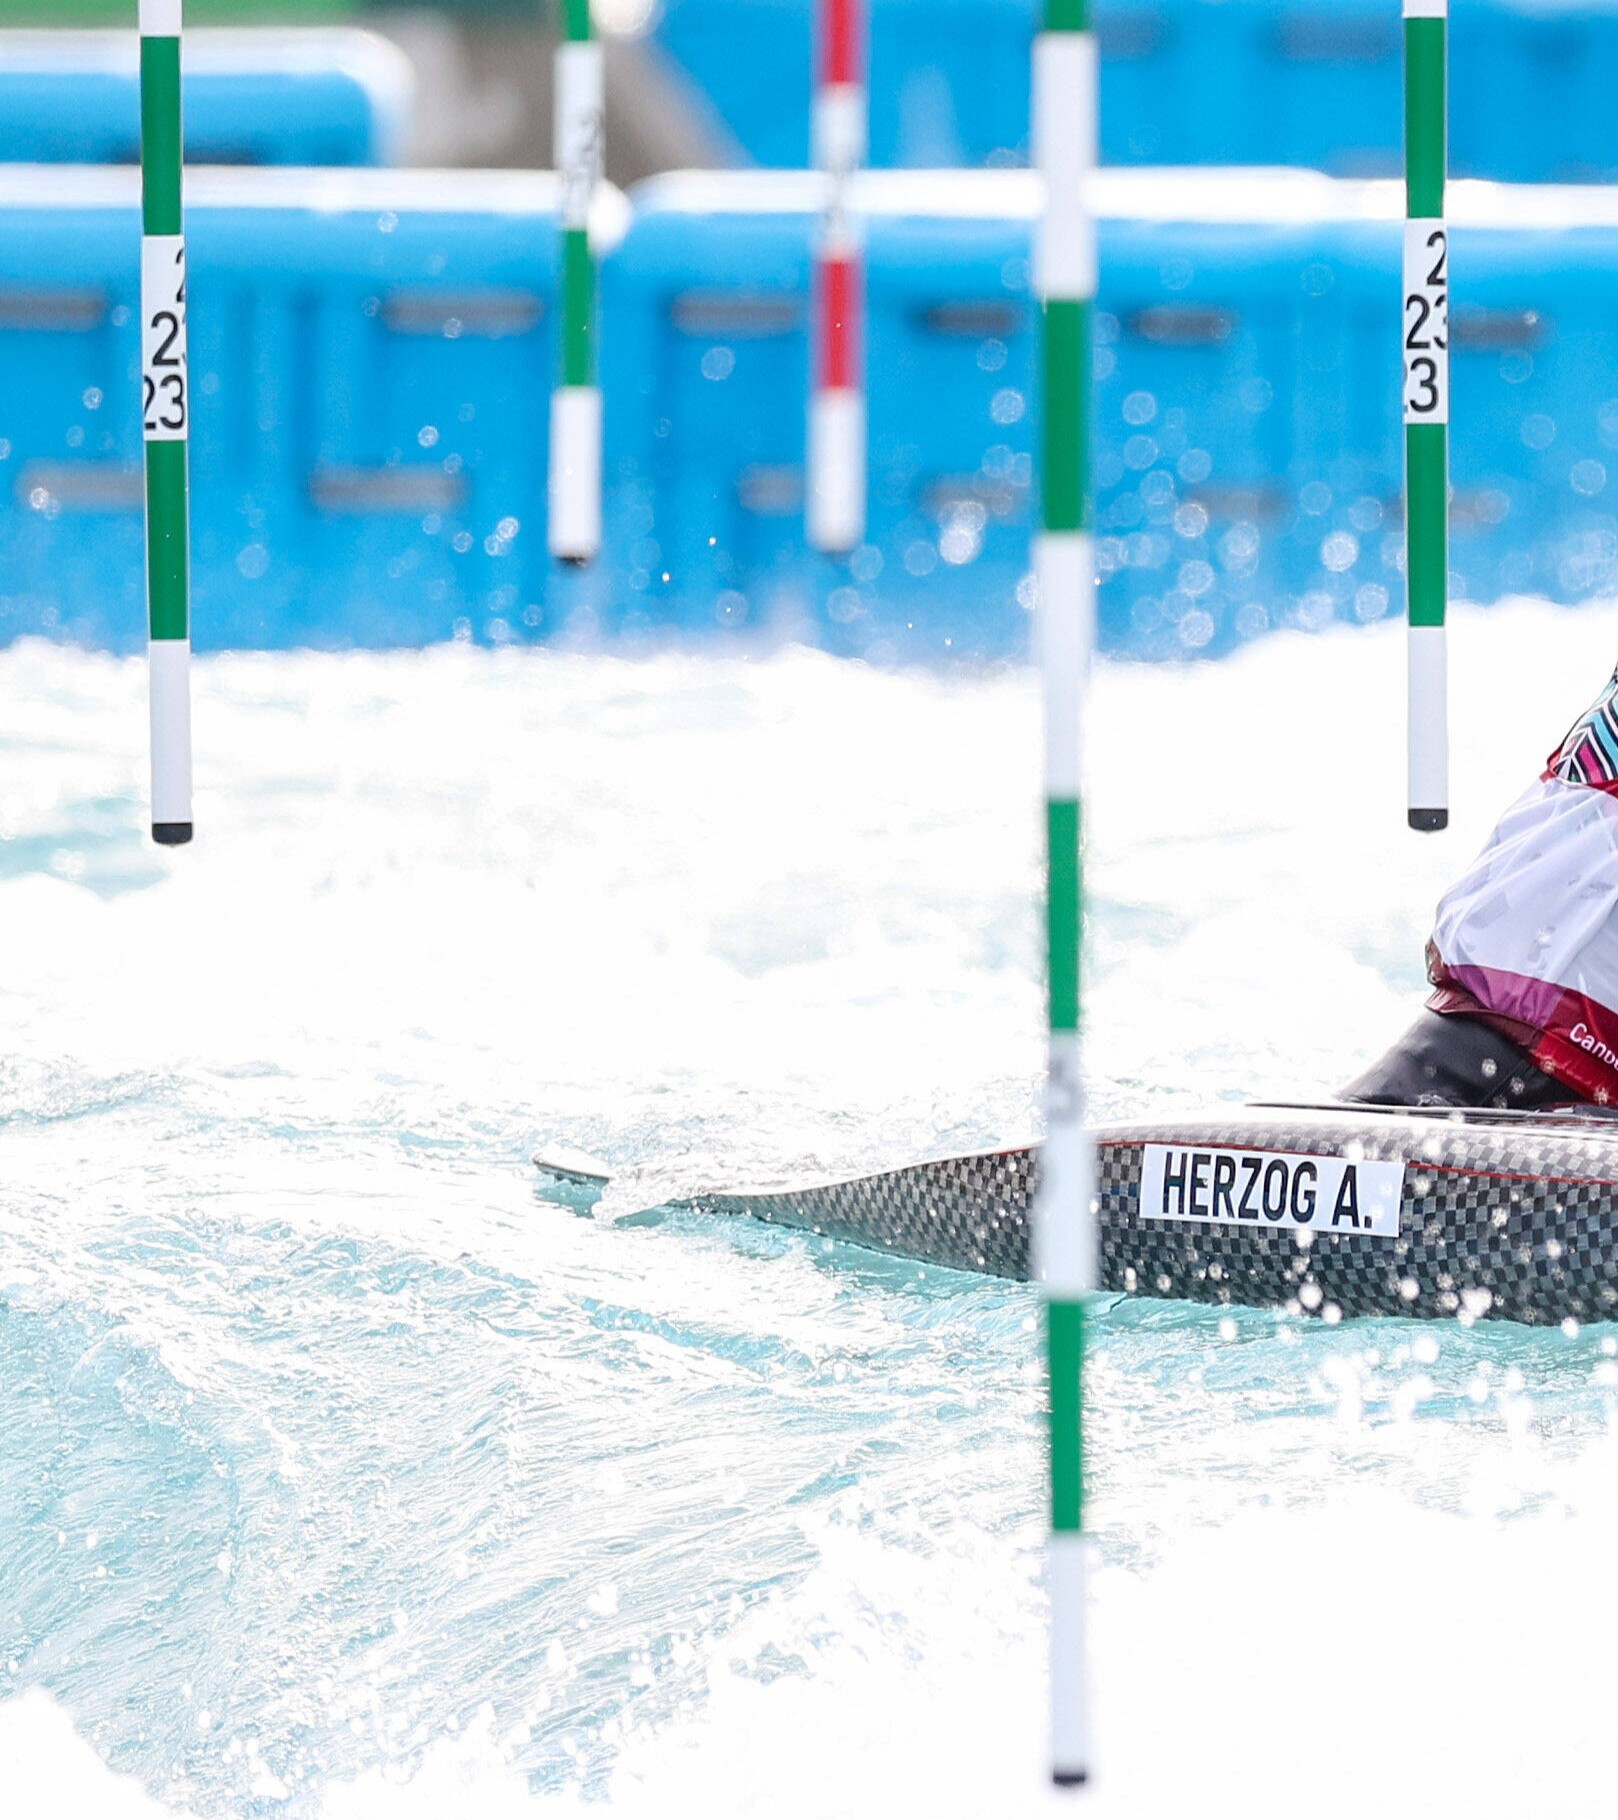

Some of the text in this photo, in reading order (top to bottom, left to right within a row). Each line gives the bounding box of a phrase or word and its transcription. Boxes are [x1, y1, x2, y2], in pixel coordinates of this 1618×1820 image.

[151, 311, 186, 366] 2
[1403, 356, 1440, 413] 3
[1162, 1151, 1374, 1229] HERZOG A.
